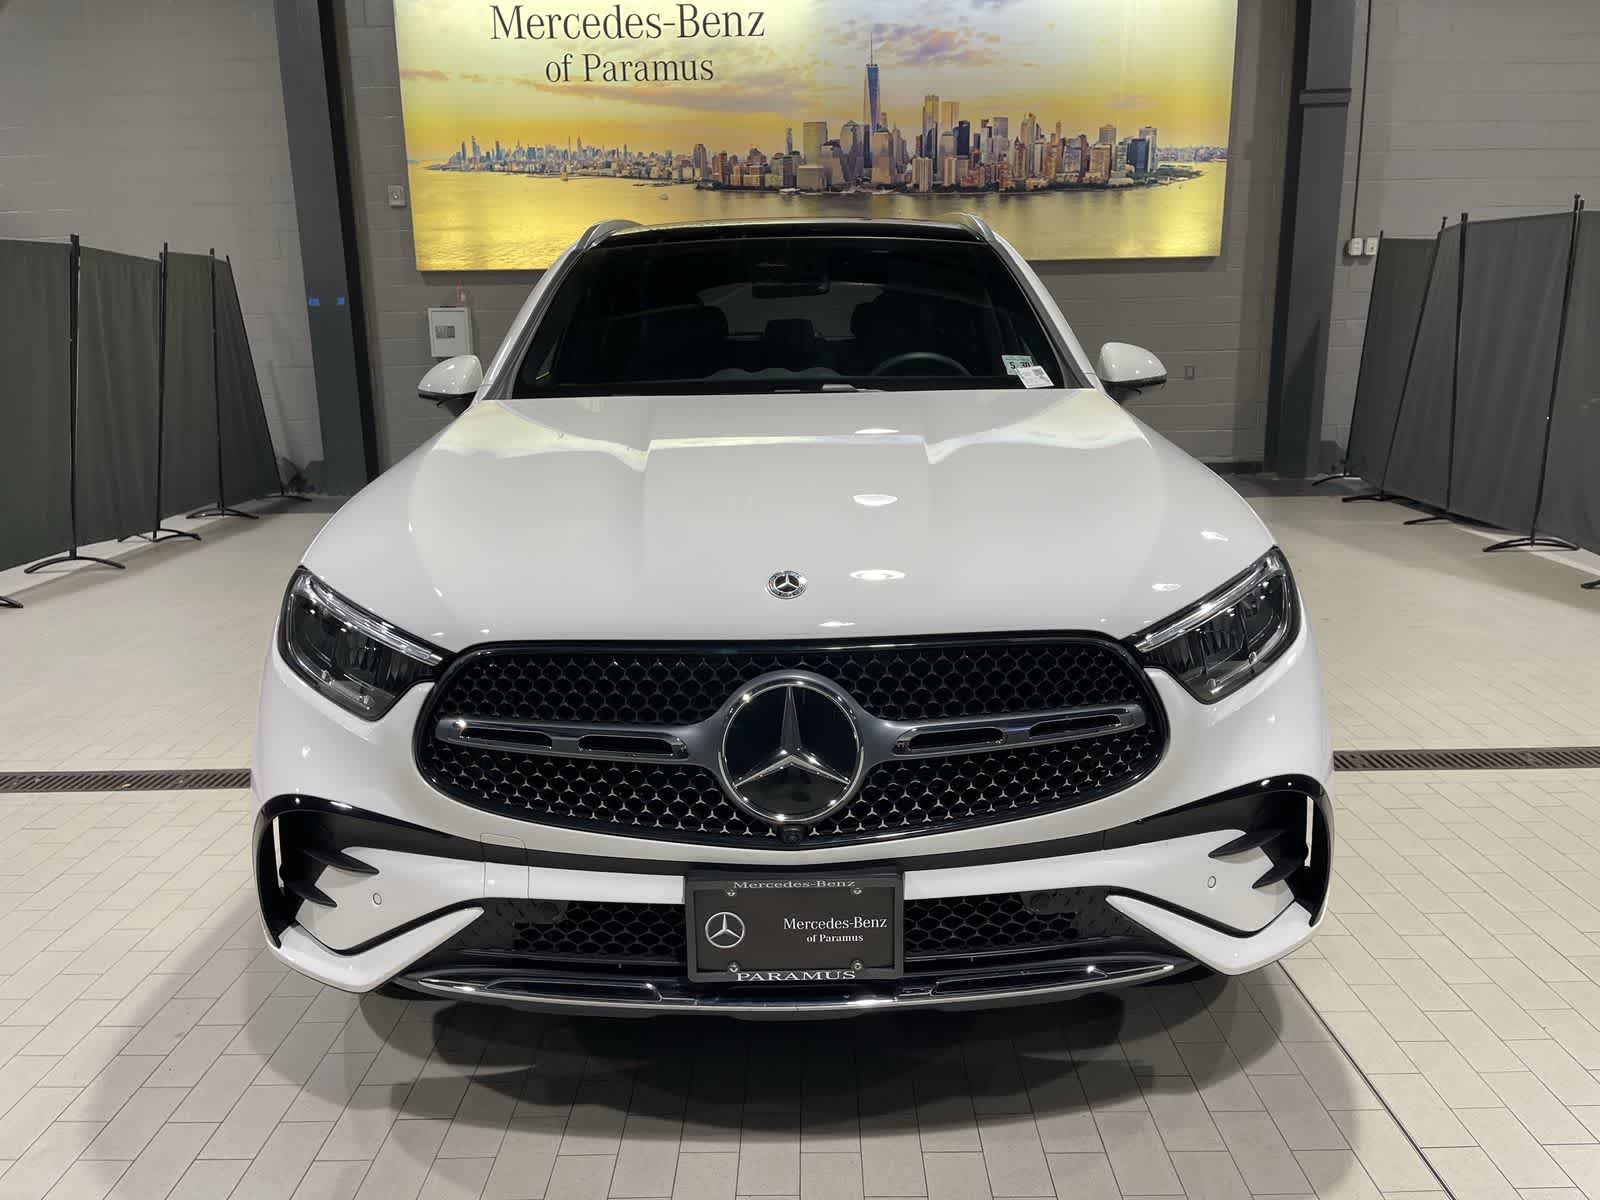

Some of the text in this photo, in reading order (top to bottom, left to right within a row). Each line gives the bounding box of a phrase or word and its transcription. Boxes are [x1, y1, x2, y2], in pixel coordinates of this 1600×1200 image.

[490, 4, 765, 40] Mercedes-Benz
[545, 53, 714, 83] of Paramus
[733, 880, 856, 889] Mercedes-Benz
[783, 916, 888, 930] Mercedes-Benz
[806, 933, 864, 943] of Paramus
[736, 970, 856, 982] PARAMUS
